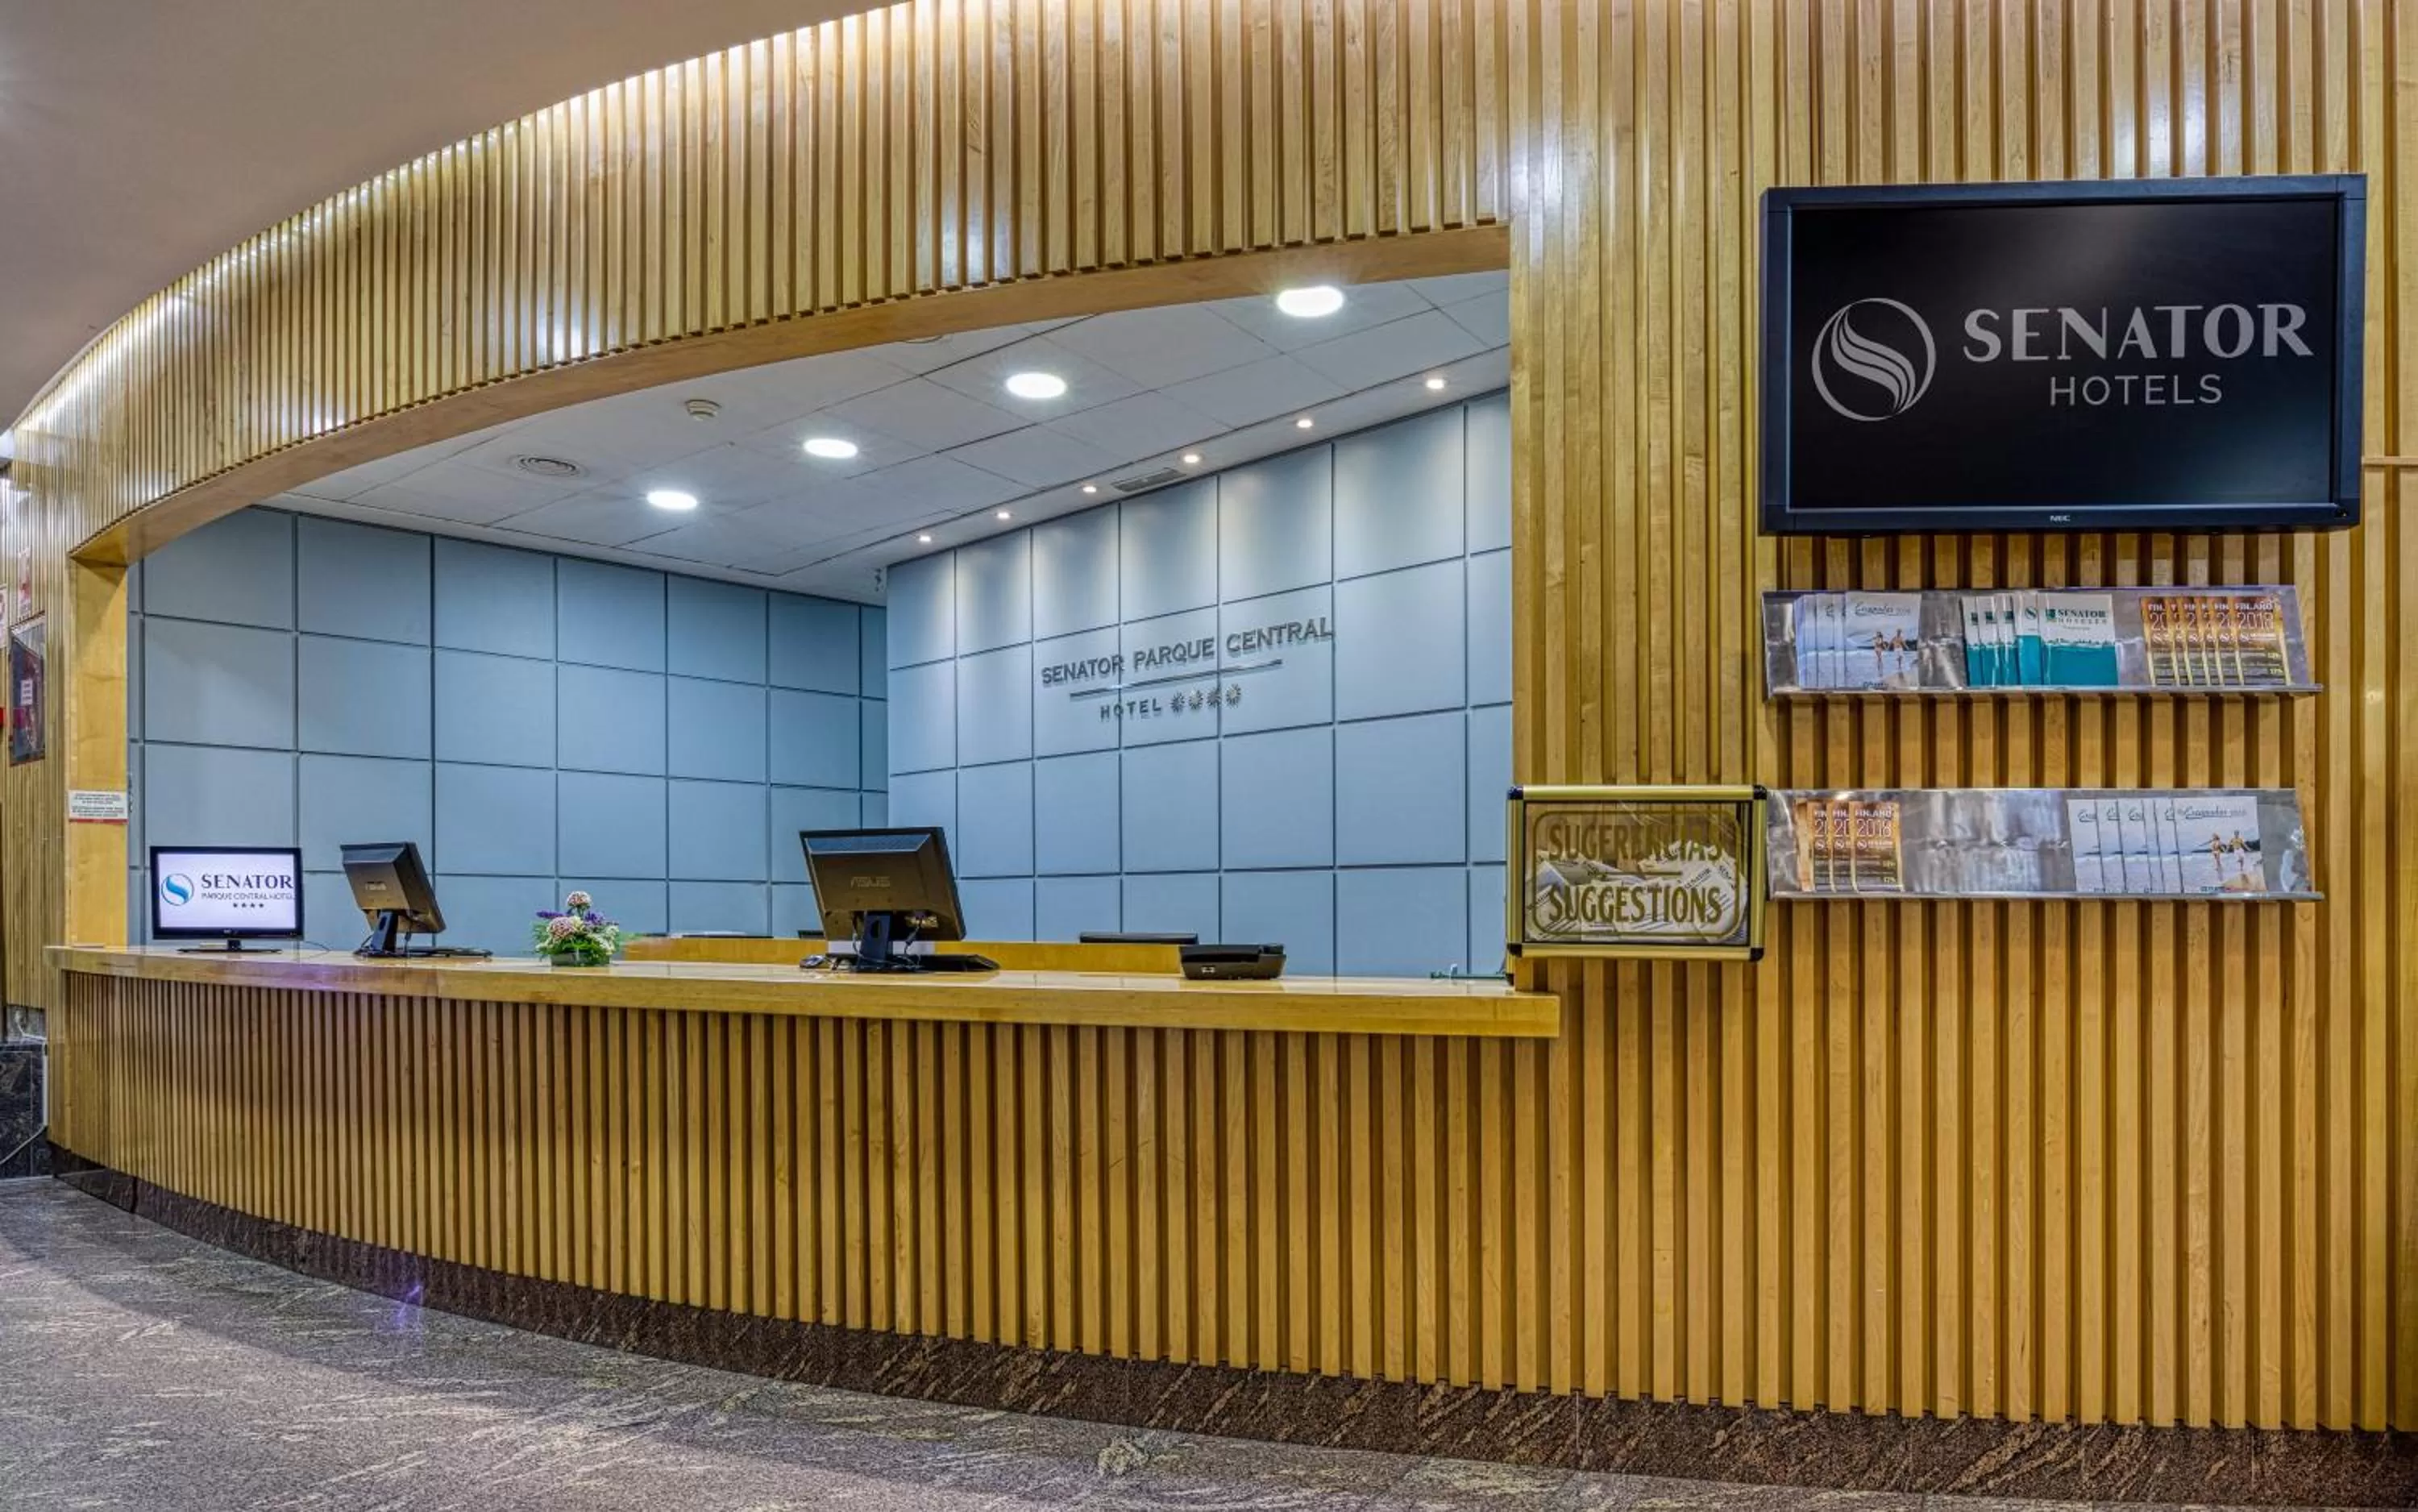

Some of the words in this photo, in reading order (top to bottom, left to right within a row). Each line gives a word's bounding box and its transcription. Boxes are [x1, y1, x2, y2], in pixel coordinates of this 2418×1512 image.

[1962, 303, 2314, 363] SENATOR
[2049, 373, 2223, 406] HOTELS
[2058, 609, 2107, 618] SENATOR
[2237, 612, 2274, 630] 2018
[1041, 654, 1124, 685] SENATOR
[1133, 637, 1215, 671] PARQUE
[1226, 617, 1334, 654] CENTRAL
[1100, 698, 1162, 721] HOTEL
[1856, 818, 1892, 837] 2018
[1548, 824, 1722, 861] SUGERENCIAS
[201, 874, 294, 889] SENATOR
[1548, 886, 1723, 924] SUGGESTIONS
